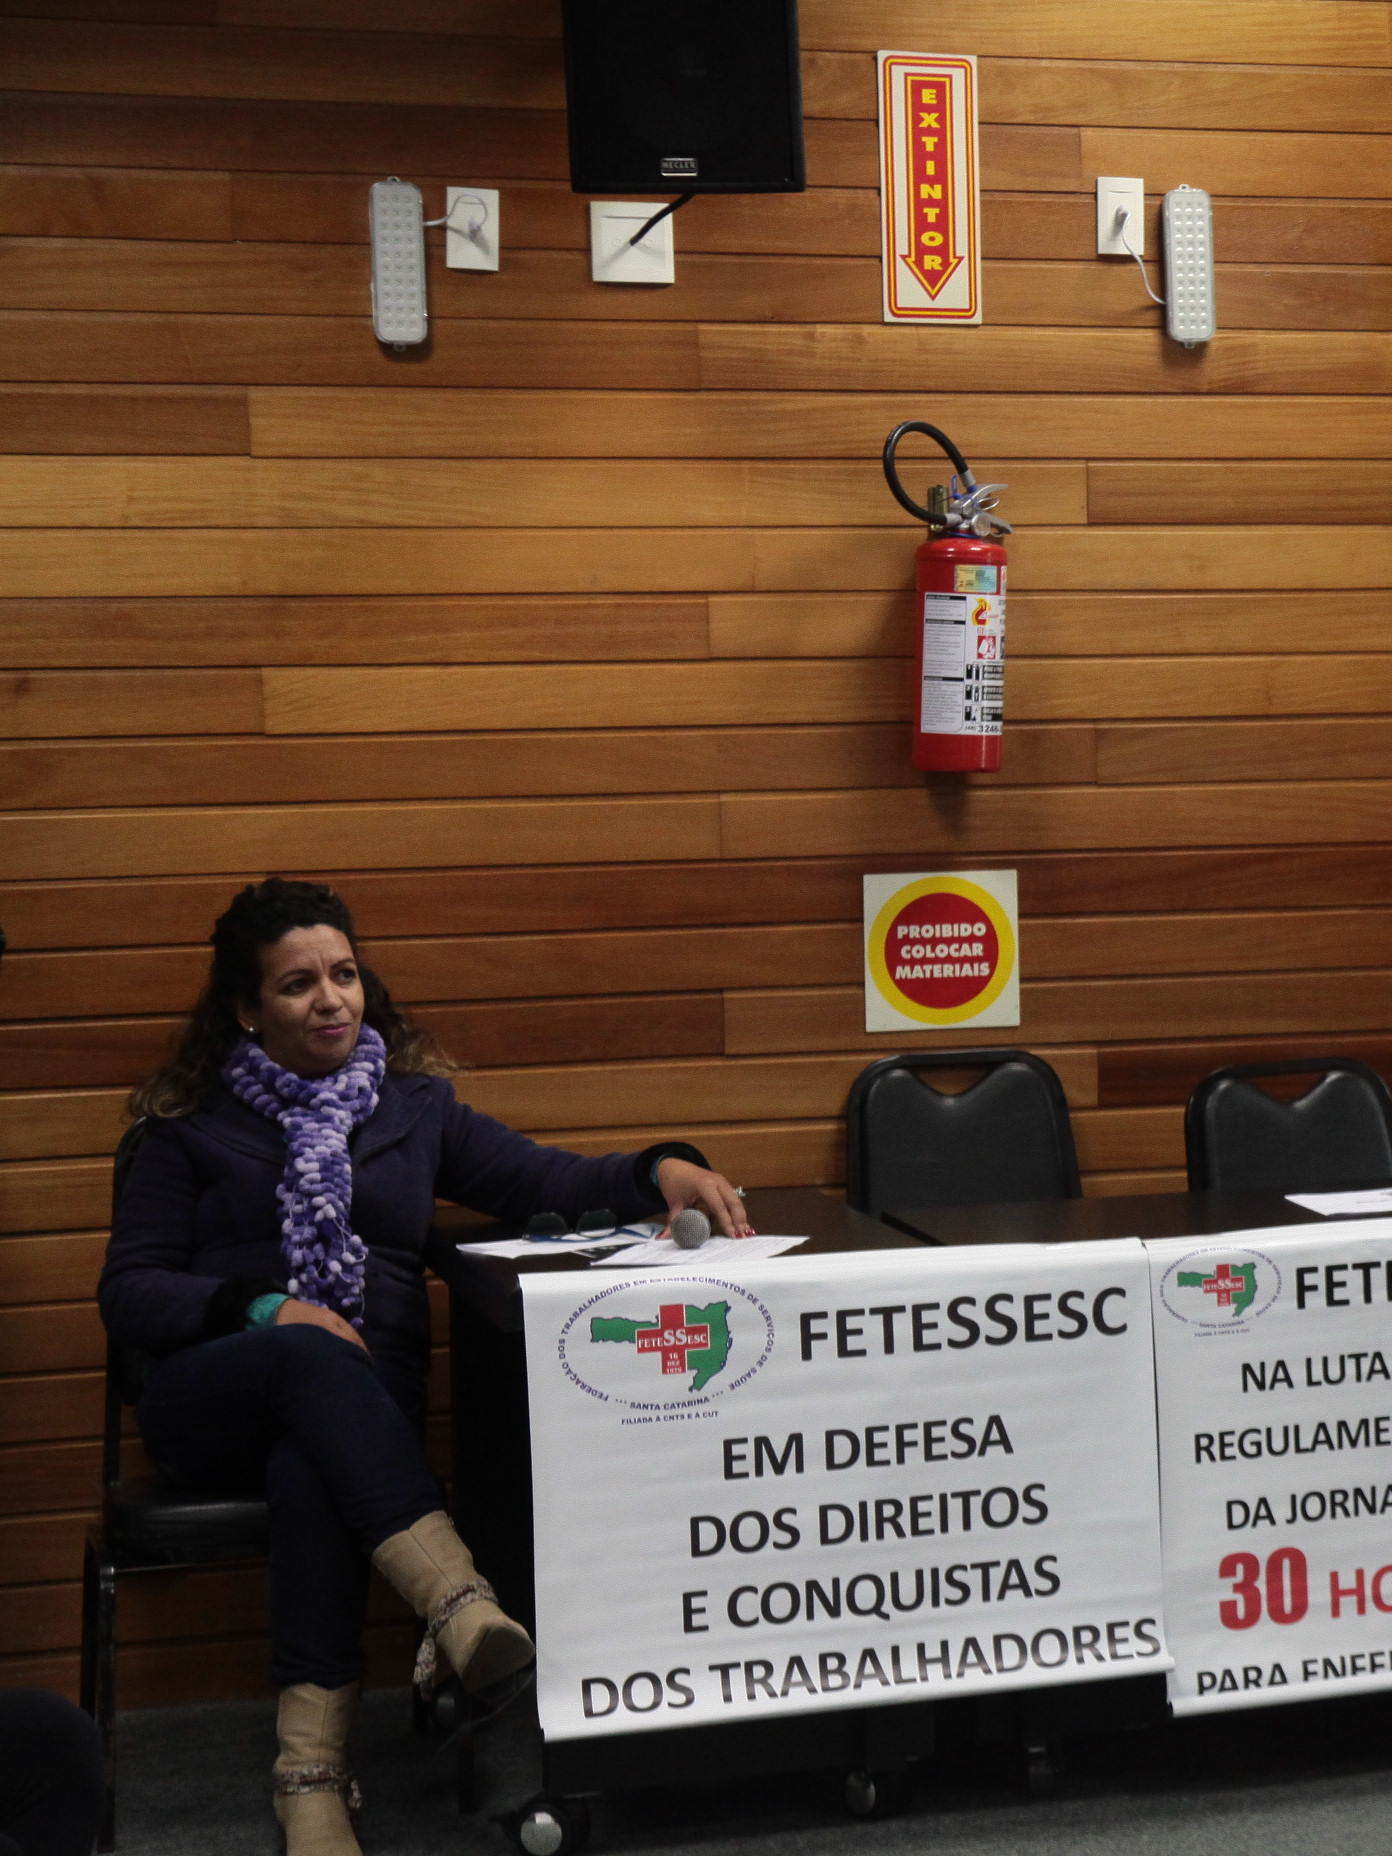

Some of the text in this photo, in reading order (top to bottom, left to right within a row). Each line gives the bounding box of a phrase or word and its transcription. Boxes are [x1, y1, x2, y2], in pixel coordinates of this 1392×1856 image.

[918, 88, 944, 271] EXTINTOR
[897, 922, 986, 939] PROIBIDO
[900, 943, 984, 959] COLOCAR
[895, 962, 990, 980] MATERIAIS
[561, 1282, 631, 1335] TRABALHADORES
[747, 1293, 758, 1305] DE
[638, 1328, 707, 1349] FETESSESC
[800, 1287, 1128, 1361] FETESSESC
[558, 1338, 566, 1360] DOS
[757, 1354, 768, 1368] DE
[1241, 1360, 1294, 1393] NA
[1305, 1351, 1390, 1387] LUTA
[630, 1396, 710, 1411] SANTA CATARINA
[621, 1417, 653, 1425] FILIADA
[722, 1414, 1014, 1480] EM DEFESA
[690, 1482, 1049, 1558] DOS DIREITOS
[1226, 1499, 1275, 1530] DA
[682, 1554, 1061, 1634] E CONQUISTAS
[1218, 1547, 1308, 1631] 30
[581, 1616, 1162, 1719] DOS TRABALHADORES
